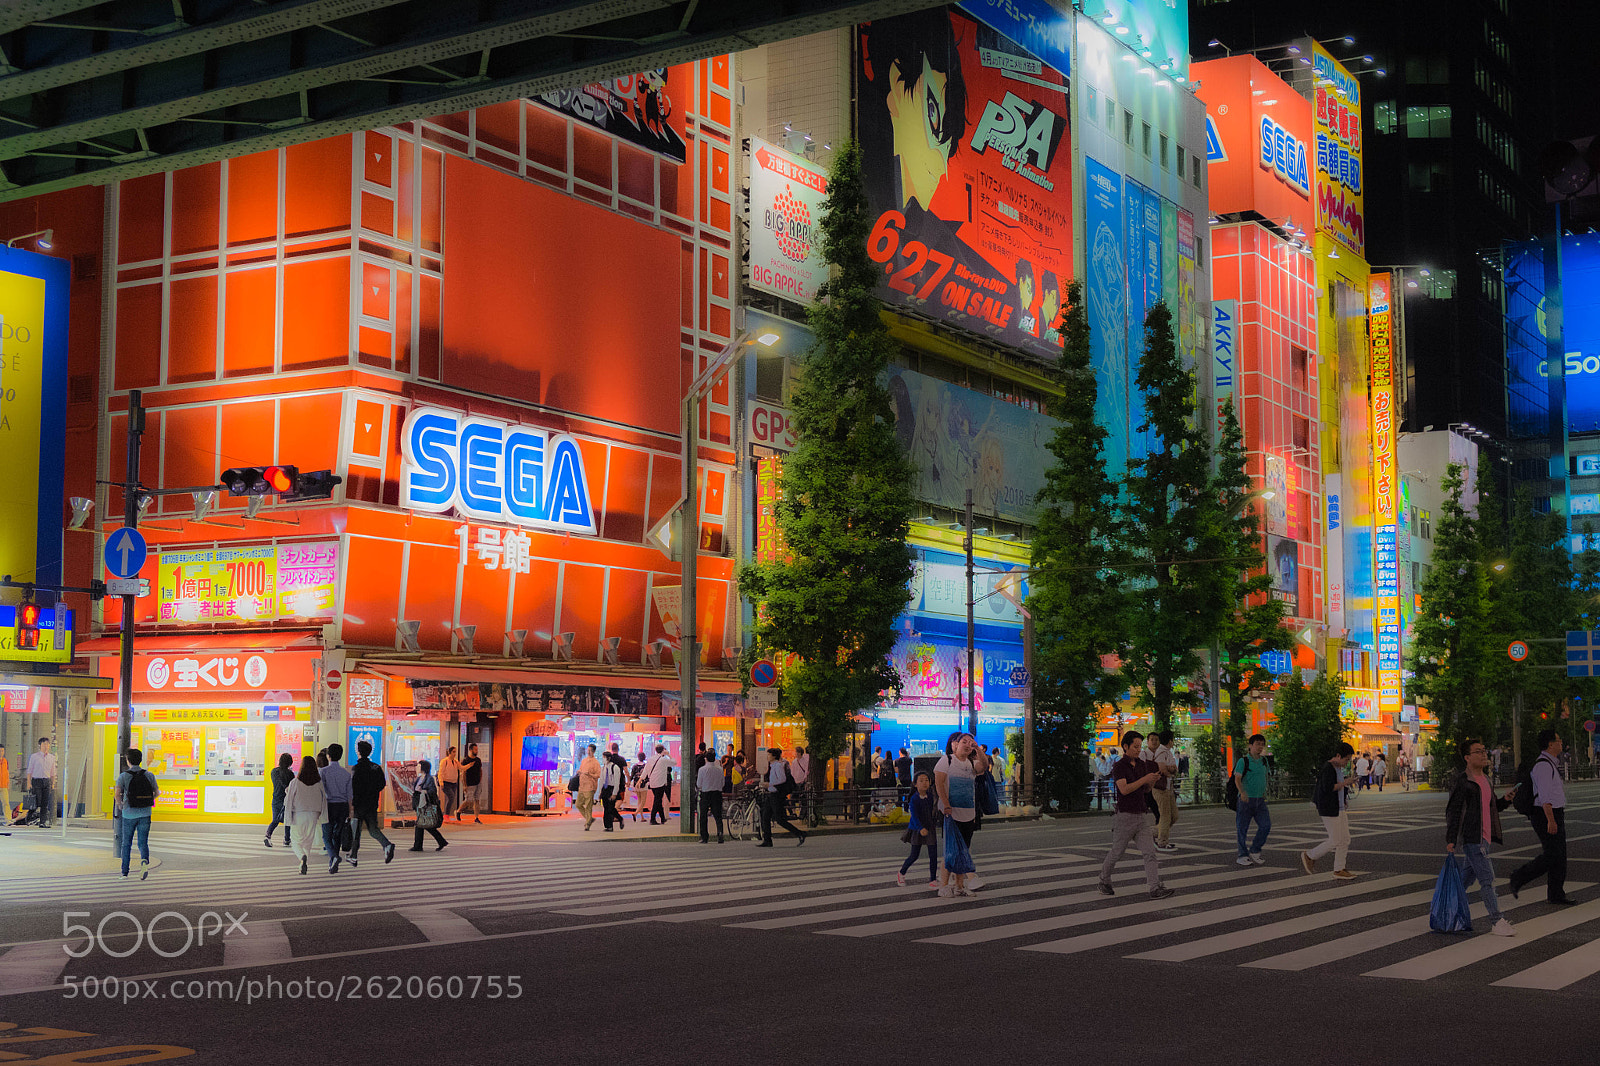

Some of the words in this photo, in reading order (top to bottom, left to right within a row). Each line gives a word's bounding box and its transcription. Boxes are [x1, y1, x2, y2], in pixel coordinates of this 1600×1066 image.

[1261, 114, 1310, 197] SEGA
[1002, 154, 1015, 171] the
[1014, 162, 1054, 193] Animation
[765, 209, 784, 233] BIG
[867, 209, 955, 300] 6.27
[754, 264, 772, 286] BIG
[771, 257, 797, 275] PACHINKO
[801, 269, 812, 281] SLOT
[941, 281, 967, 311] ON
[967, 292, 1014, 329] SALE
[1371, 314, 1389, 324] DVD
[1215, 305, 1231, 372] AKKY
[1565, 352, 1600, 375] So
[402, 406, 597, 535] SEGA
[1327, 494, 1340, 531] SEGA
[281, 549, 335, 563] ギフトカード
[455, 525, 531, 574] 1号館
[1380, 643, 1398, 652] DVD
[1512, 646, 1524, 656] 50
[173, 657, 239, 688] 宝くじ
[1011, 672, 1028, 680] 437
